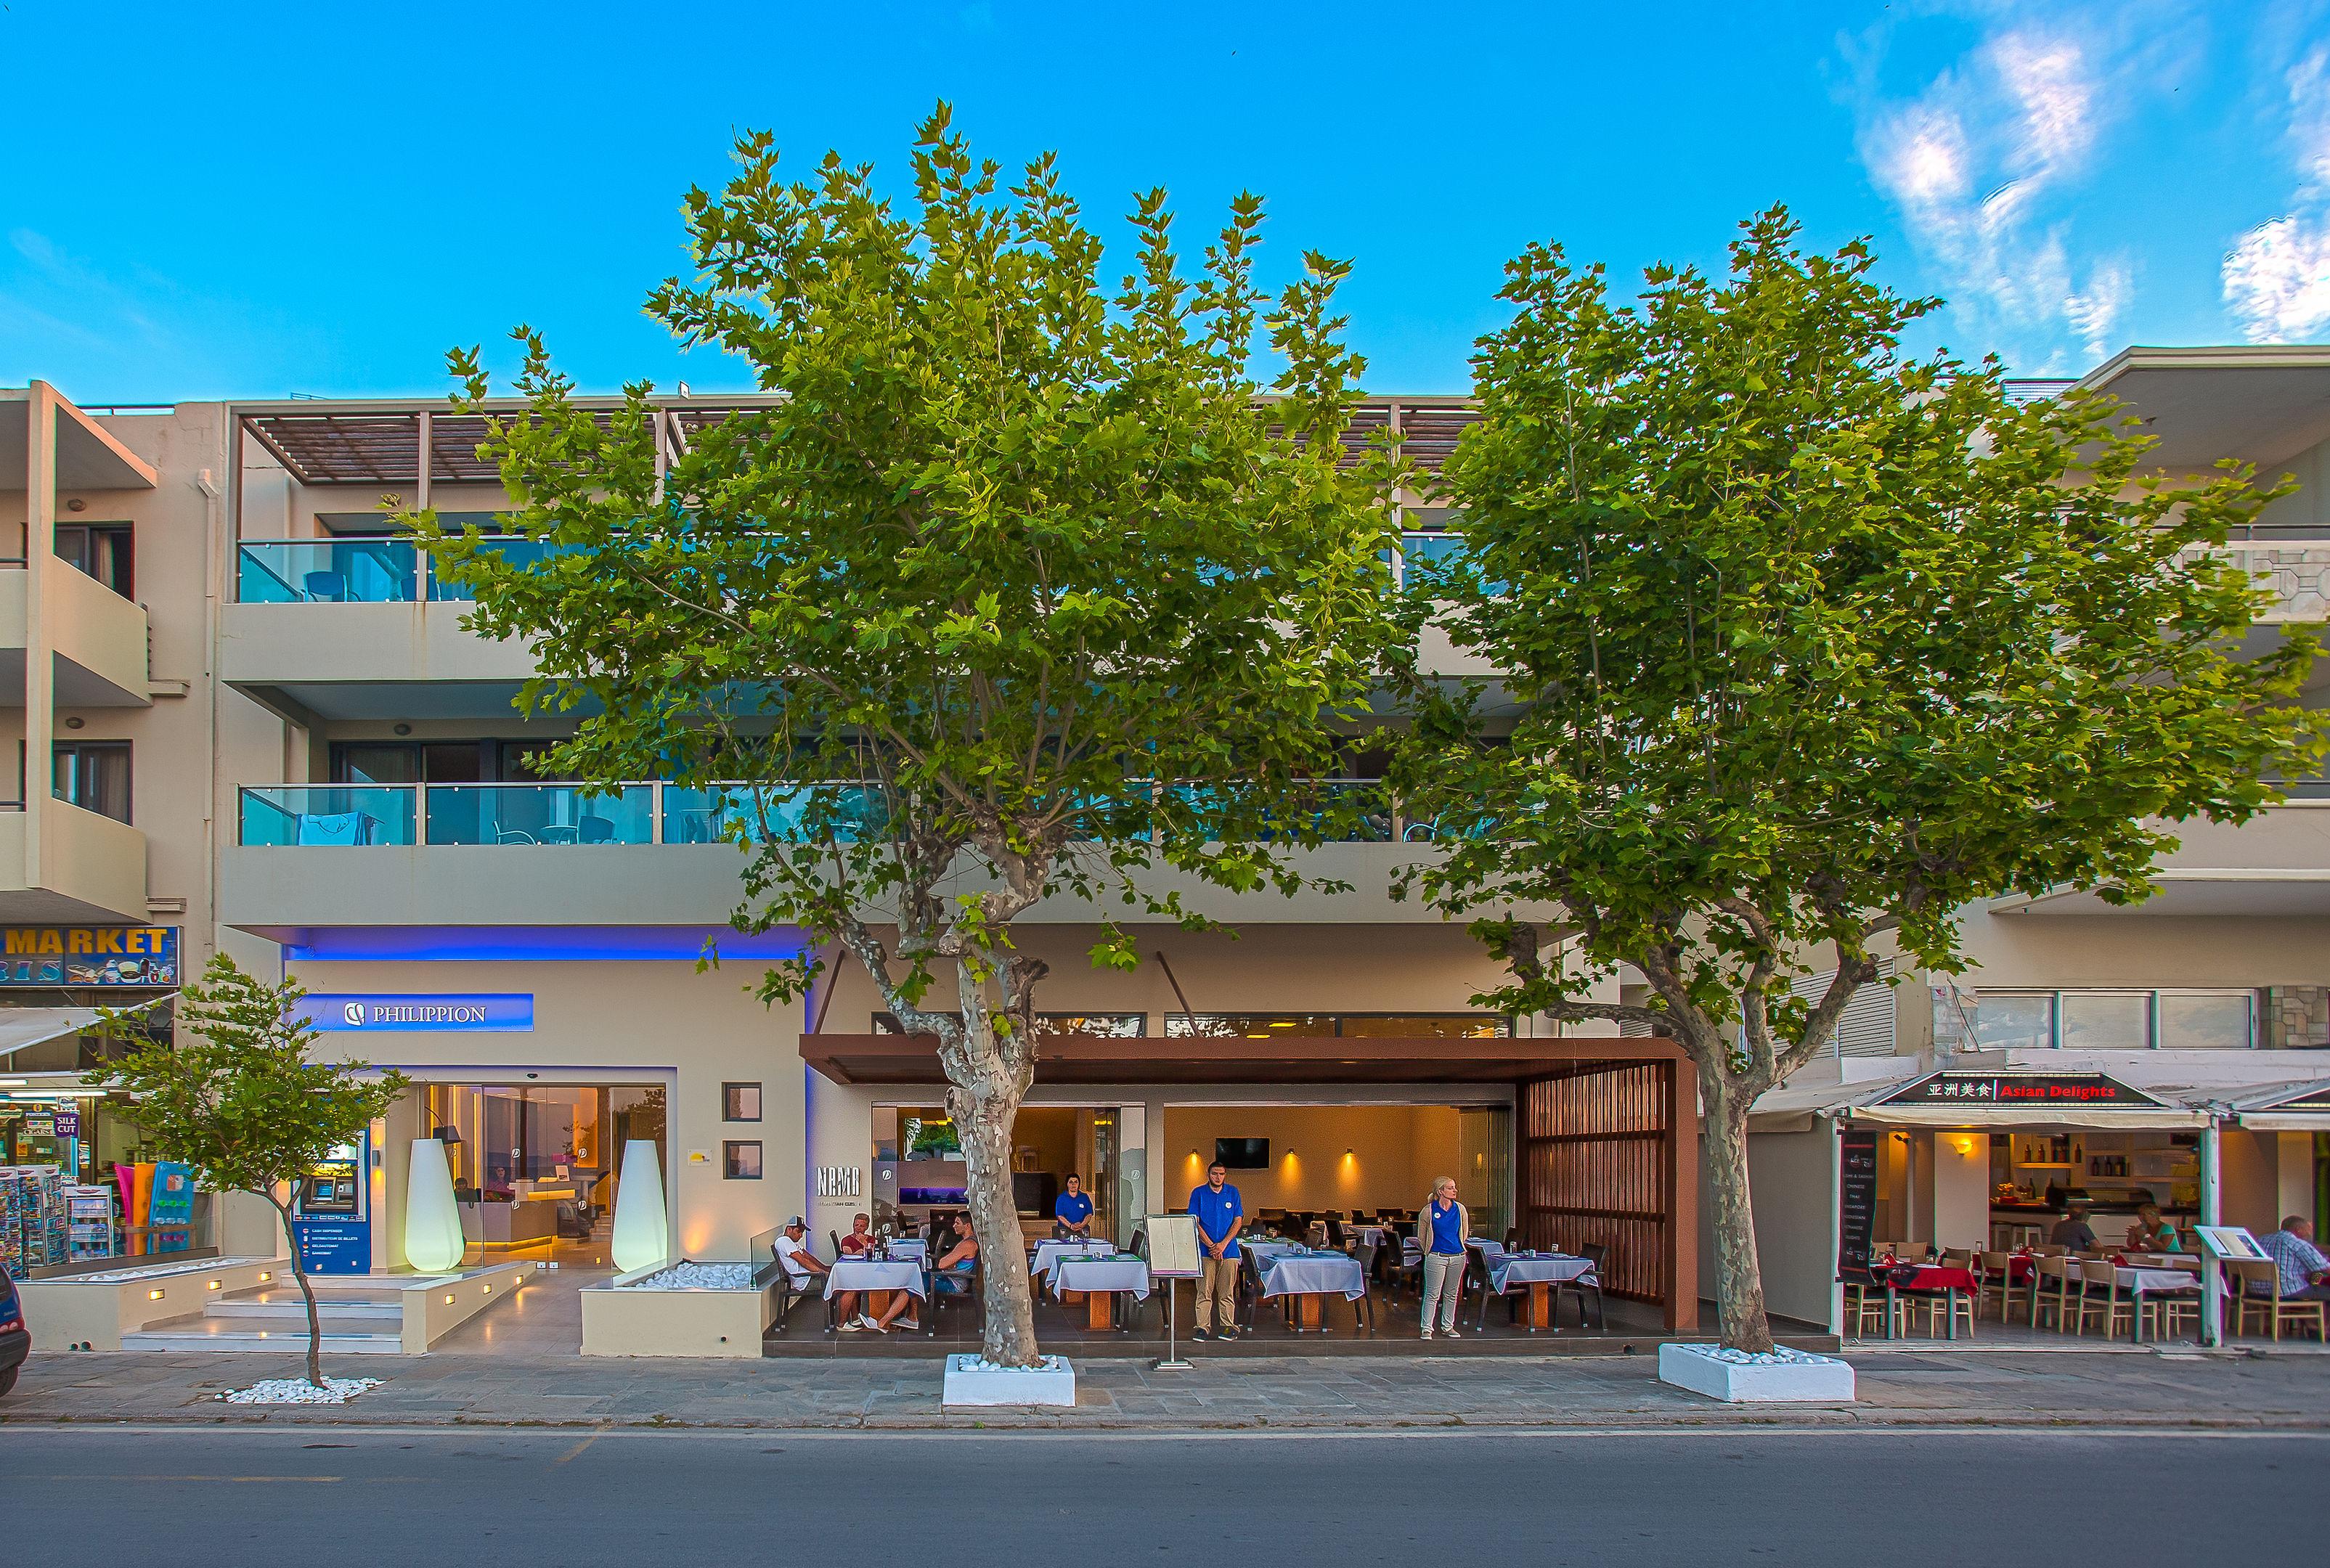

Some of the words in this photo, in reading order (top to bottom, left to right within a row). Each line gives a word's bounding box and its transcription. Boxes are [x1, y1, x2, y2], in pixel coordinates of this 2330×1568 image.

[6, 929, 167, 954] MARKET
[373, 1007, 486, 1023] PHILIPPION
[1927, 1082, 1992, 1097] 亚洲美食
[2001, 1085, 2045, 1097] Asian
[2050, 1085, 2115, 1100] Delights
